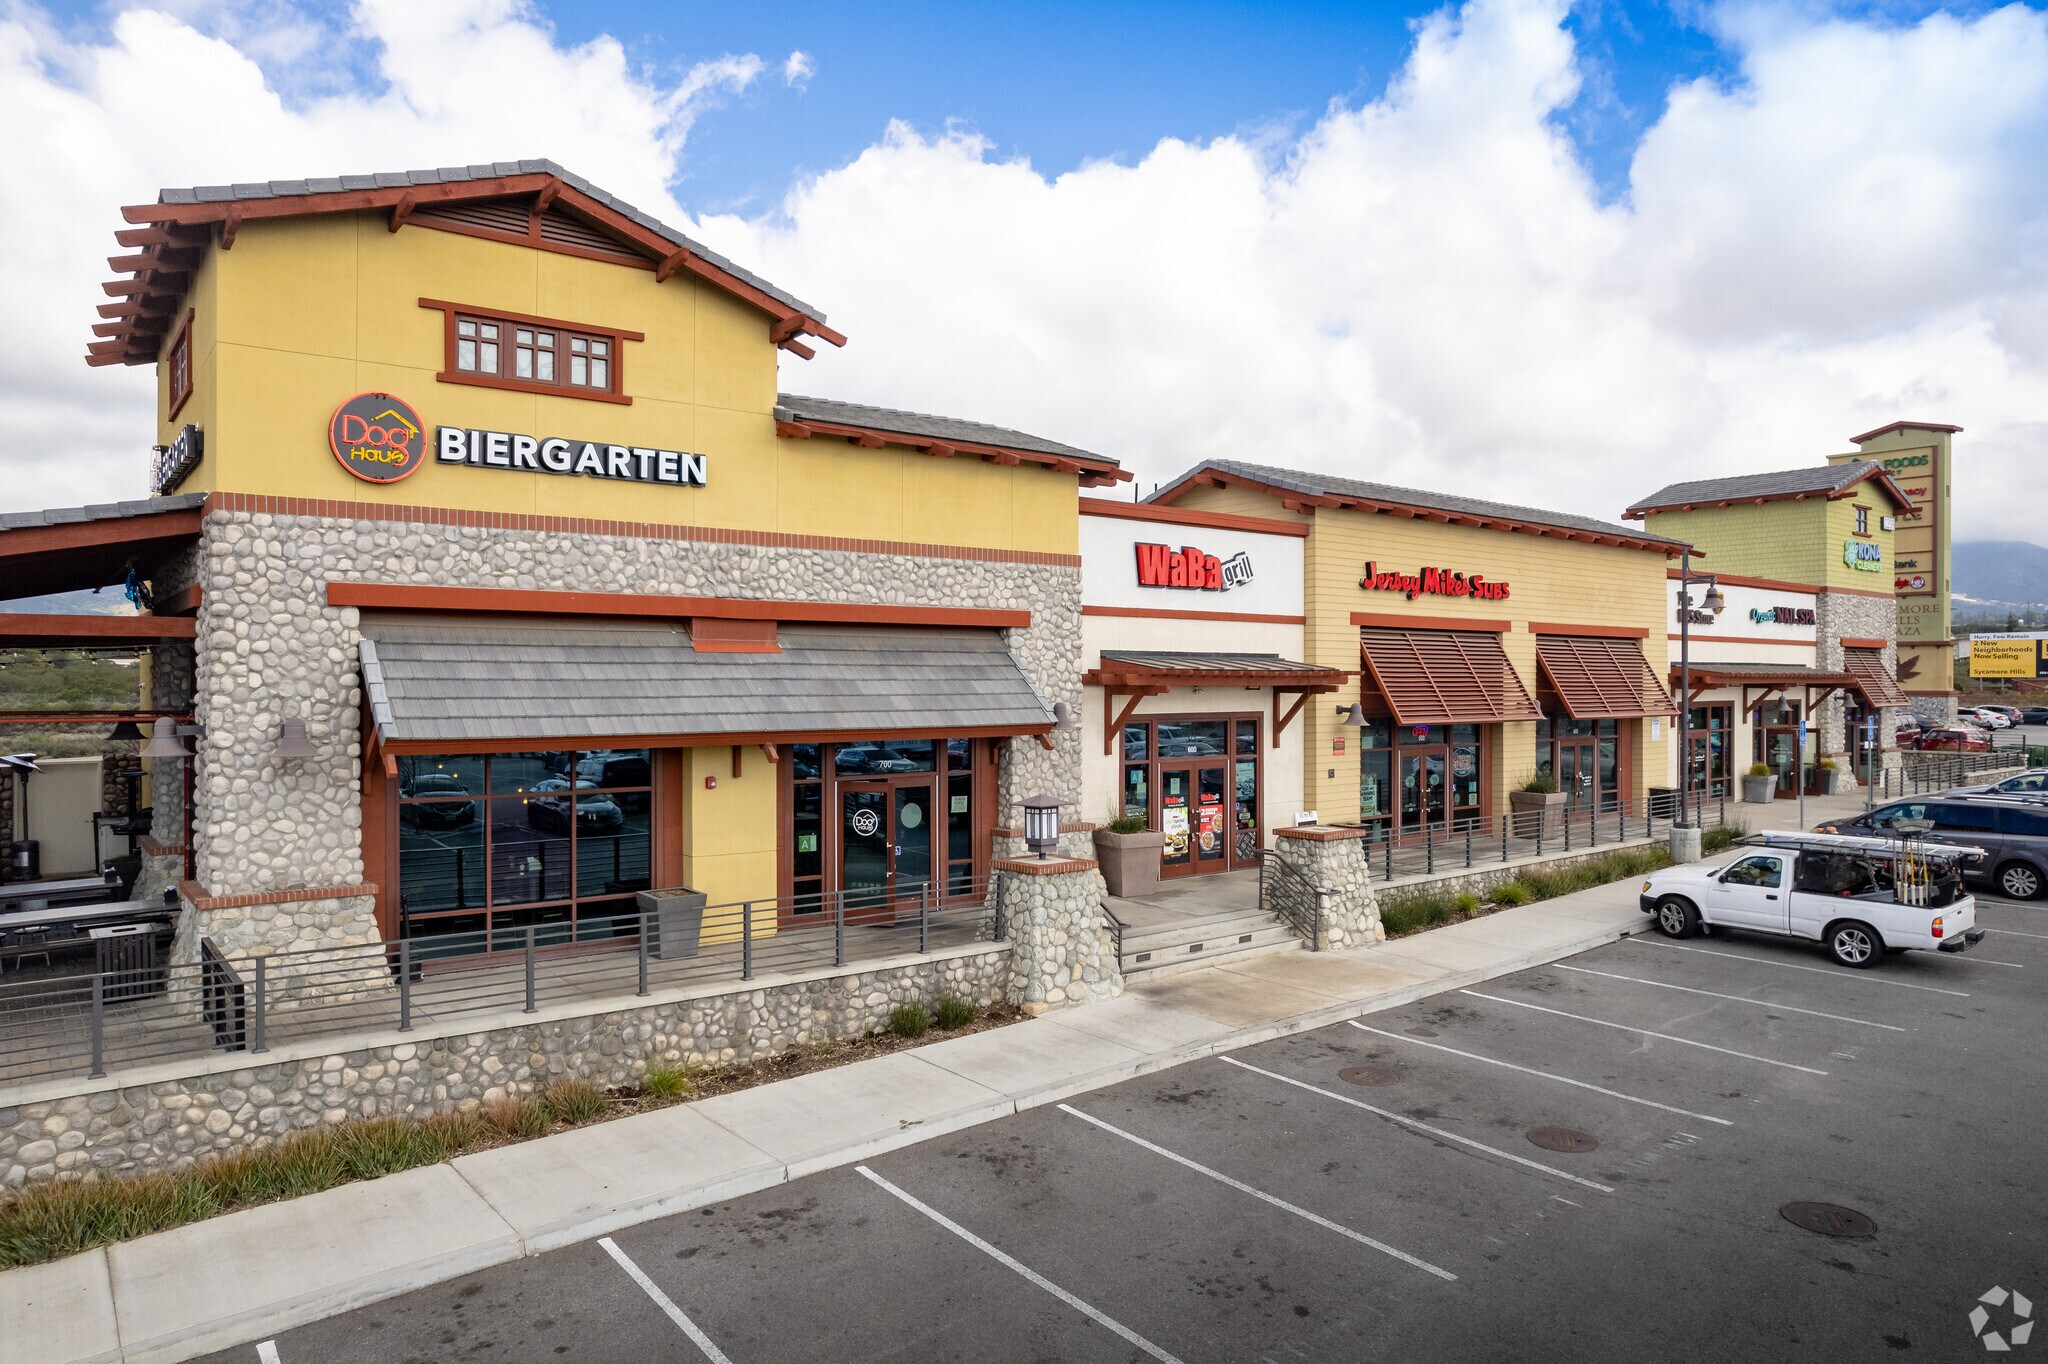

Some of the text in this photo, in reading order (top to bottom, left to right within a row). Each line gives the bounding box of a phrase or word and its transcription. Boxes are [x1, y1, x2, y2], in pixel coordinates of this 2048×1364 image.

[342, 413, 410, 468] Dog
[350, 446, 405, 463] Haus
[438, 426, 707, 485] BIERGARTEN
[1884, 455, 1929, 469] FOODS
[1858, 542, 1881, 561] KONA
[1135, 543, 1254, 590] WaBa grill
[1856, 561, 1883, 572] CLEANERS
[1361, 561, 1421, 600] Jersey
[1775, 607, 1798, 624] NAIL
[1798, 609, 1816, 625] SPA
[1899, 604, 1940, 614] MORE
[1896, 627, 1921, 636] AZA
[879, 760, 892, 768] 700
[801, 840, 809, 849] A
